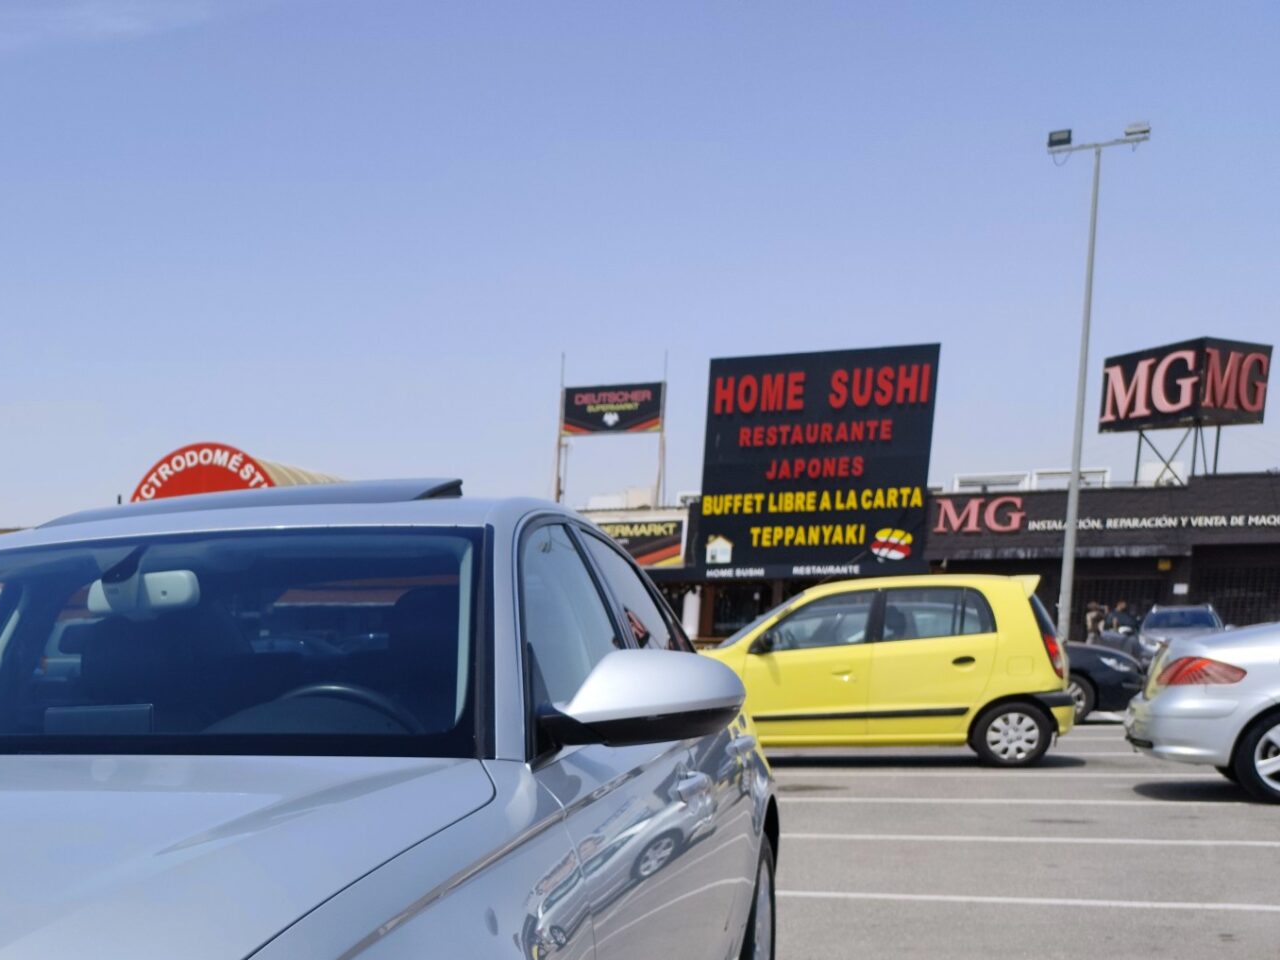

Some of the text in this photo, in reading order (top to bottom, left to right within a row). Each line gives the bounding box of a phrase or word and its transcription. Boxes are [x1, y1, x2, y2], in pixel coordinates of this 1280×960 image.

[714, 363, 931, 415] HOME SUSHI
[1099, 350, 1200, 423] MG
[1201, 347, 1269, 413] MG
[739, 419, 893, 447] RESTAURANTE
[134, 448, 269, 503] CTRODOMÉST
[766, 456, 864, 480] JAPONES
[702, 486, 923, 516] BUFFET LIBRE A LA CARTA
[933, 496, 1026, 533] MG
[602, 523, 677, 537] ERMARKT
[1181, 516, 1190, 527] Y
[1190, 515, 1227, 527] VENTA
[1230, 515, 1245, 527] DE
[1248, 514, 1280, 527] MAQ
[751, 524, 866, 548] TEPPANYAKI
[706, 568, 734, 578] HOME
[792, 565, 860, 576] RESTAURANTE
